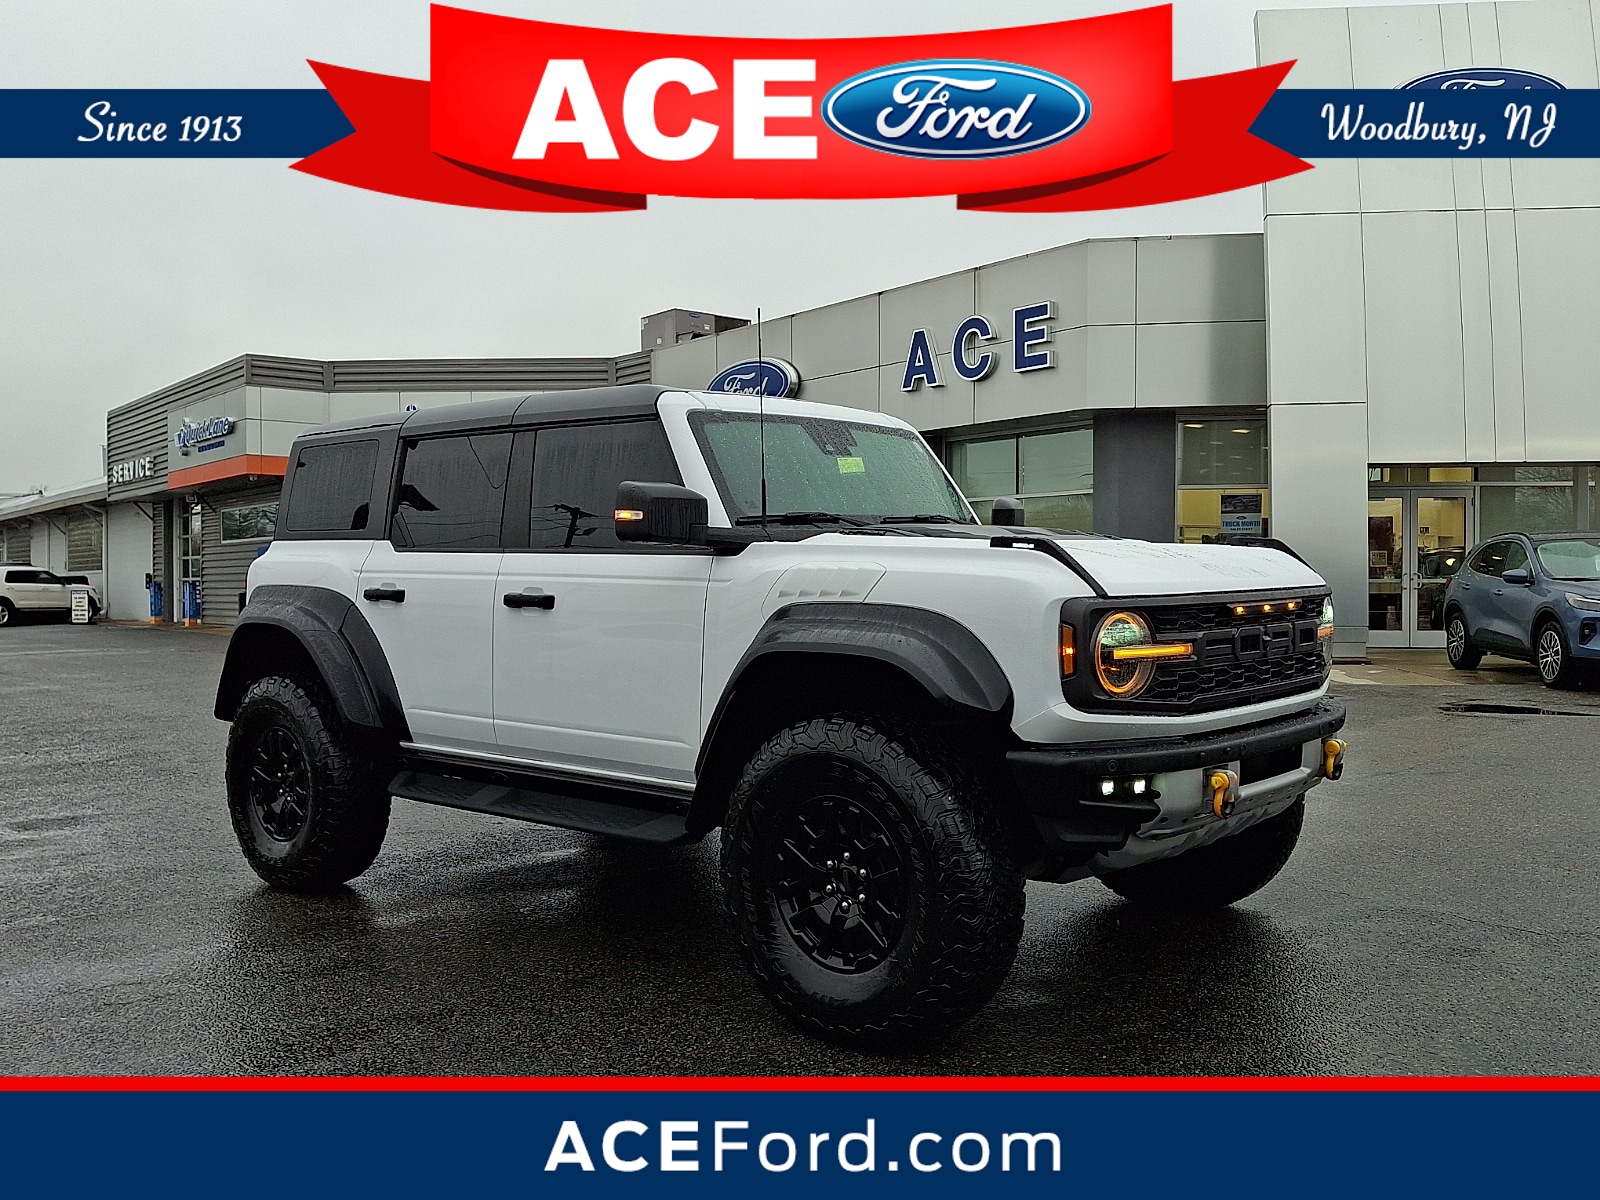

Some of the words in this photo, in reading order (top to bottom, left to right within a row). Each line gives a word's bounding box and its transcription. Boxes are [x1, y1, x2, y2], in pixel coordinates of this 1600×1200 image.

[900, 300, 1056, 392] ACE
[723, 372, 769, 396] Frd
[112, 457, 154, 483] SERVICE
[1198, 620, 1319, 667] FORD
